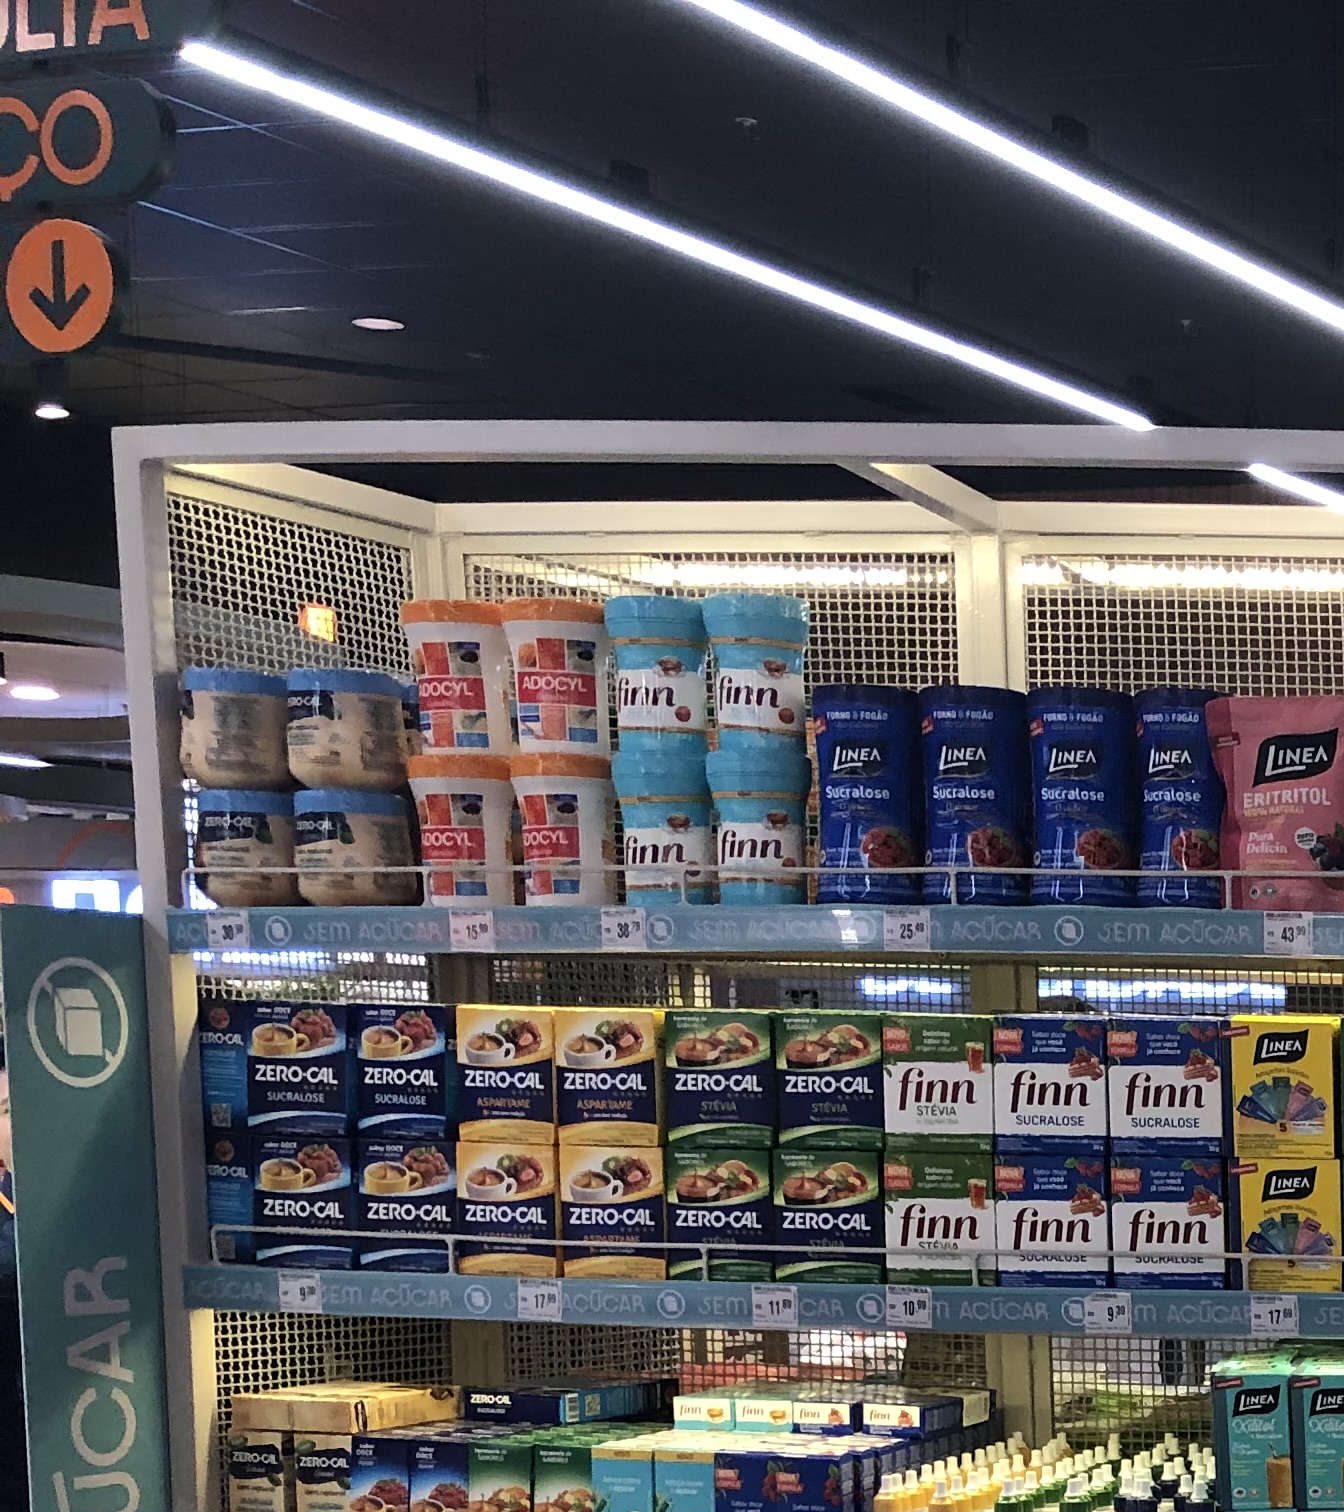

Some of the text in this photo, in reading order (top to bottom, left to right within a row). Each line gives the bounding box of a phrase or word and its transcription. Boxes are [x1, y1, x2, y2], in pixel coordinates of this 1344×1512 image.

[521, 674, 588, 694] ADOCYL
[618, 675, 676, 709] finn
[718, 677, 780, 711] finn
[834, 745, 882, 770] LINEA
[939, 744, 987, 770] LINEA
[1264, 744, 1329, 776] LINEA
[825, 785, 890, 801] Sucralose
[1040, 787, 1105, 802] Sucralose
[1242, 789, 1332, 809] ERITRITOL
[720, 830, 784, 862] finn
[1259, 1035, 1302, 1060] LINEA
[255, 1064, 339, 1084] ZERO-CAL
[363, 1066, 439, 1086] ZERO-CAL
[464, 1070, 545, 1090] ZERO-CAL
[563, 1071, 647, 1091] ZERO-CAL
[674, 1073, 764, 1094] ZERO-CAL
[784, 1074, 875, 1095] ZERO-CAL
[267, 1091, 325, 1104] SUCRALOSE
[899, 1066, 978, 1112] finn
[1010, 1070, 1091, 1114] finn
[1015, 1113, 1085, 1127] SUCRALOSE
[1240, 1390, 1279, 1412] LINEA
